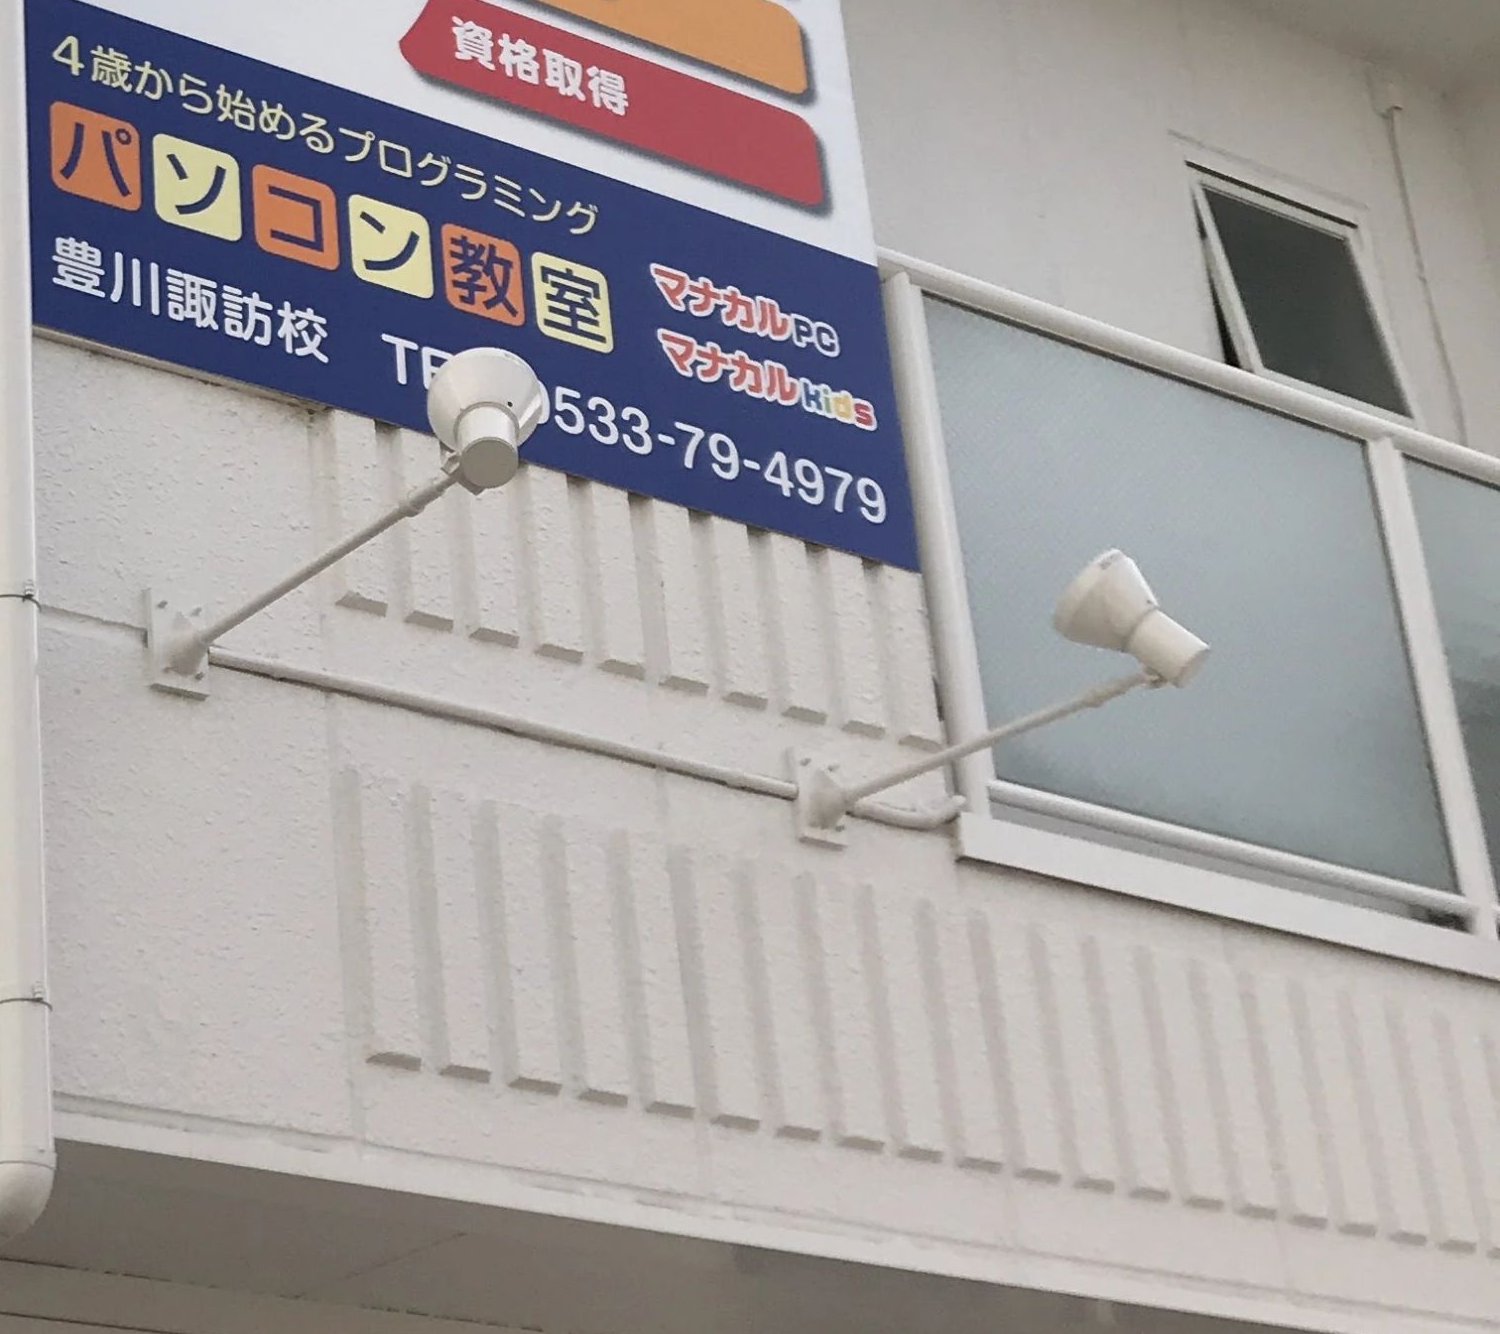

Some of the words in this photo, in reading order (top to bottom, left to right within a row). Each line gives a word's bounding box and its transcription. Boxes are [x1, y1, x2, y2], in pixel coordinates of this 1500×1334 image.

[451, 15, 630, 116] 資格取得
[60, 122, 603, 342] パソコン教室
[52, 236, 329, 364] 豊川諏訪校
[537, 379, 887, 524] 533-79-4979
